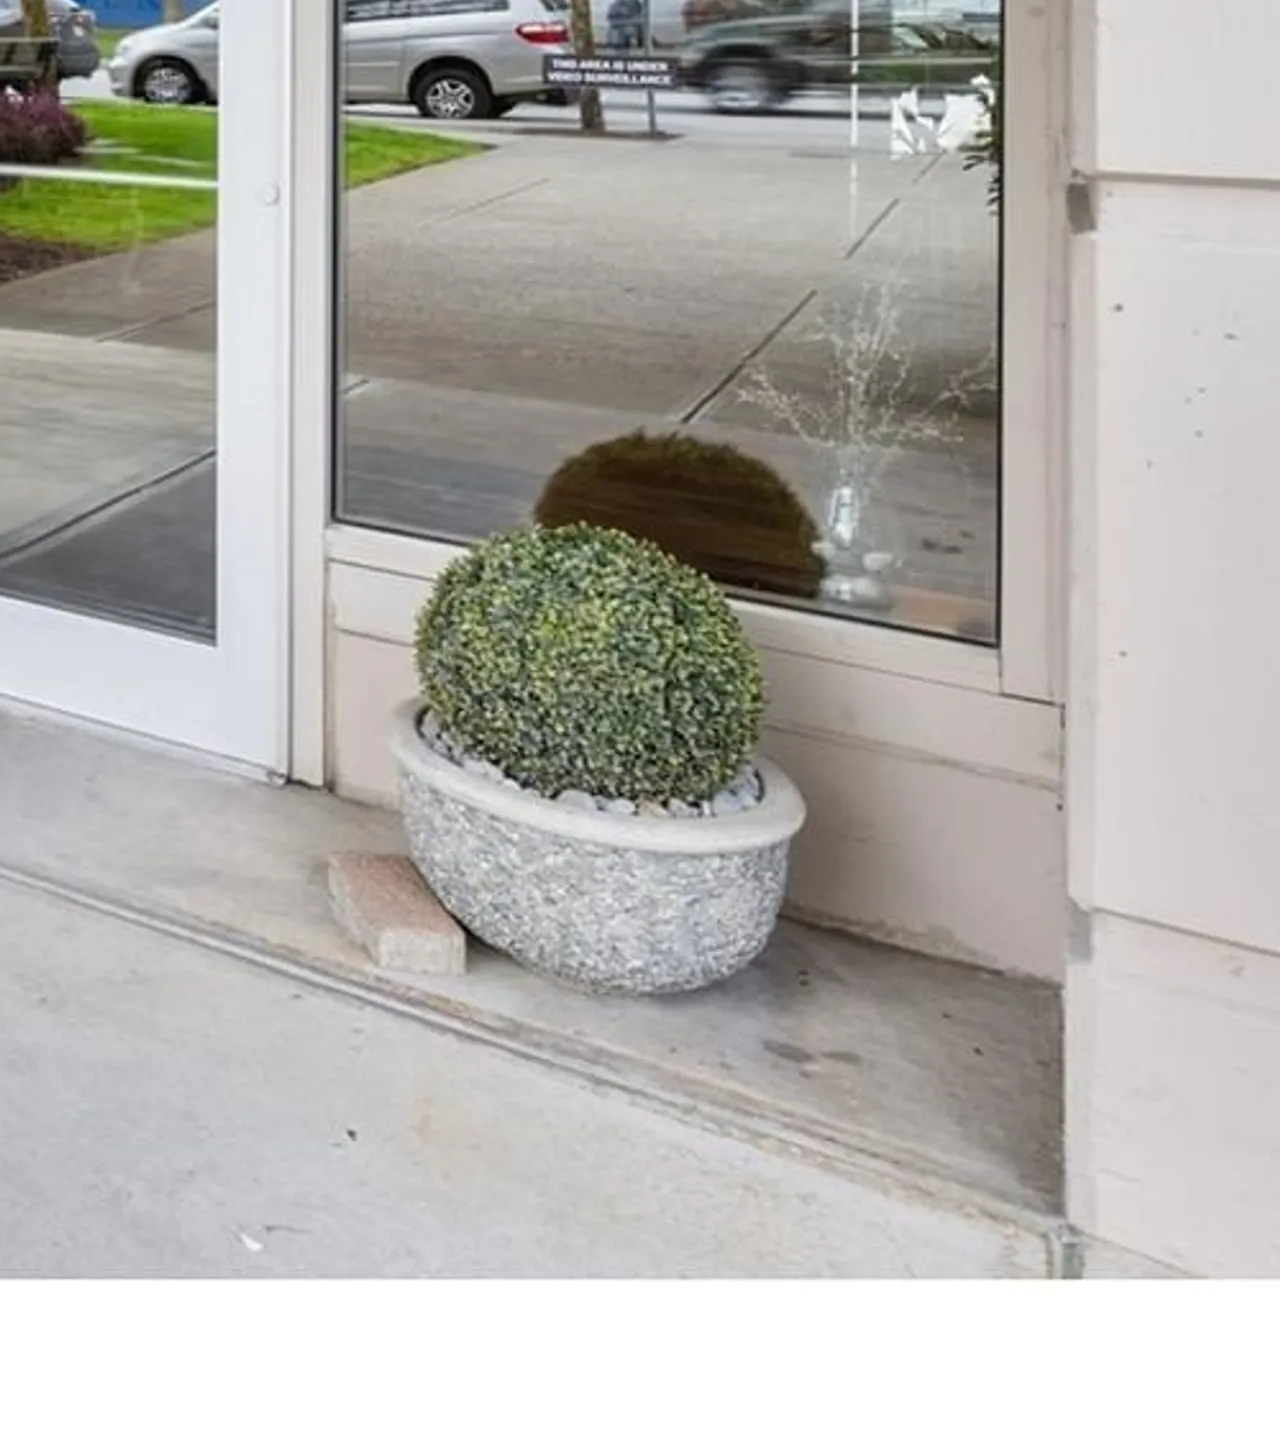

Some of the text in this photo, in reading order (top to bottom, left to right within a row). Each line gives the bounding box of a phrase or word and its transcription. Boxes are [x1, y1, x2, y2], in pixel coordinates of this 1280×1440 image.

[579, 59, 610, 70] AREA
[627, 61, 668, 72] UNDER
[585, 73, 672, 85] SURVEILLANCE
